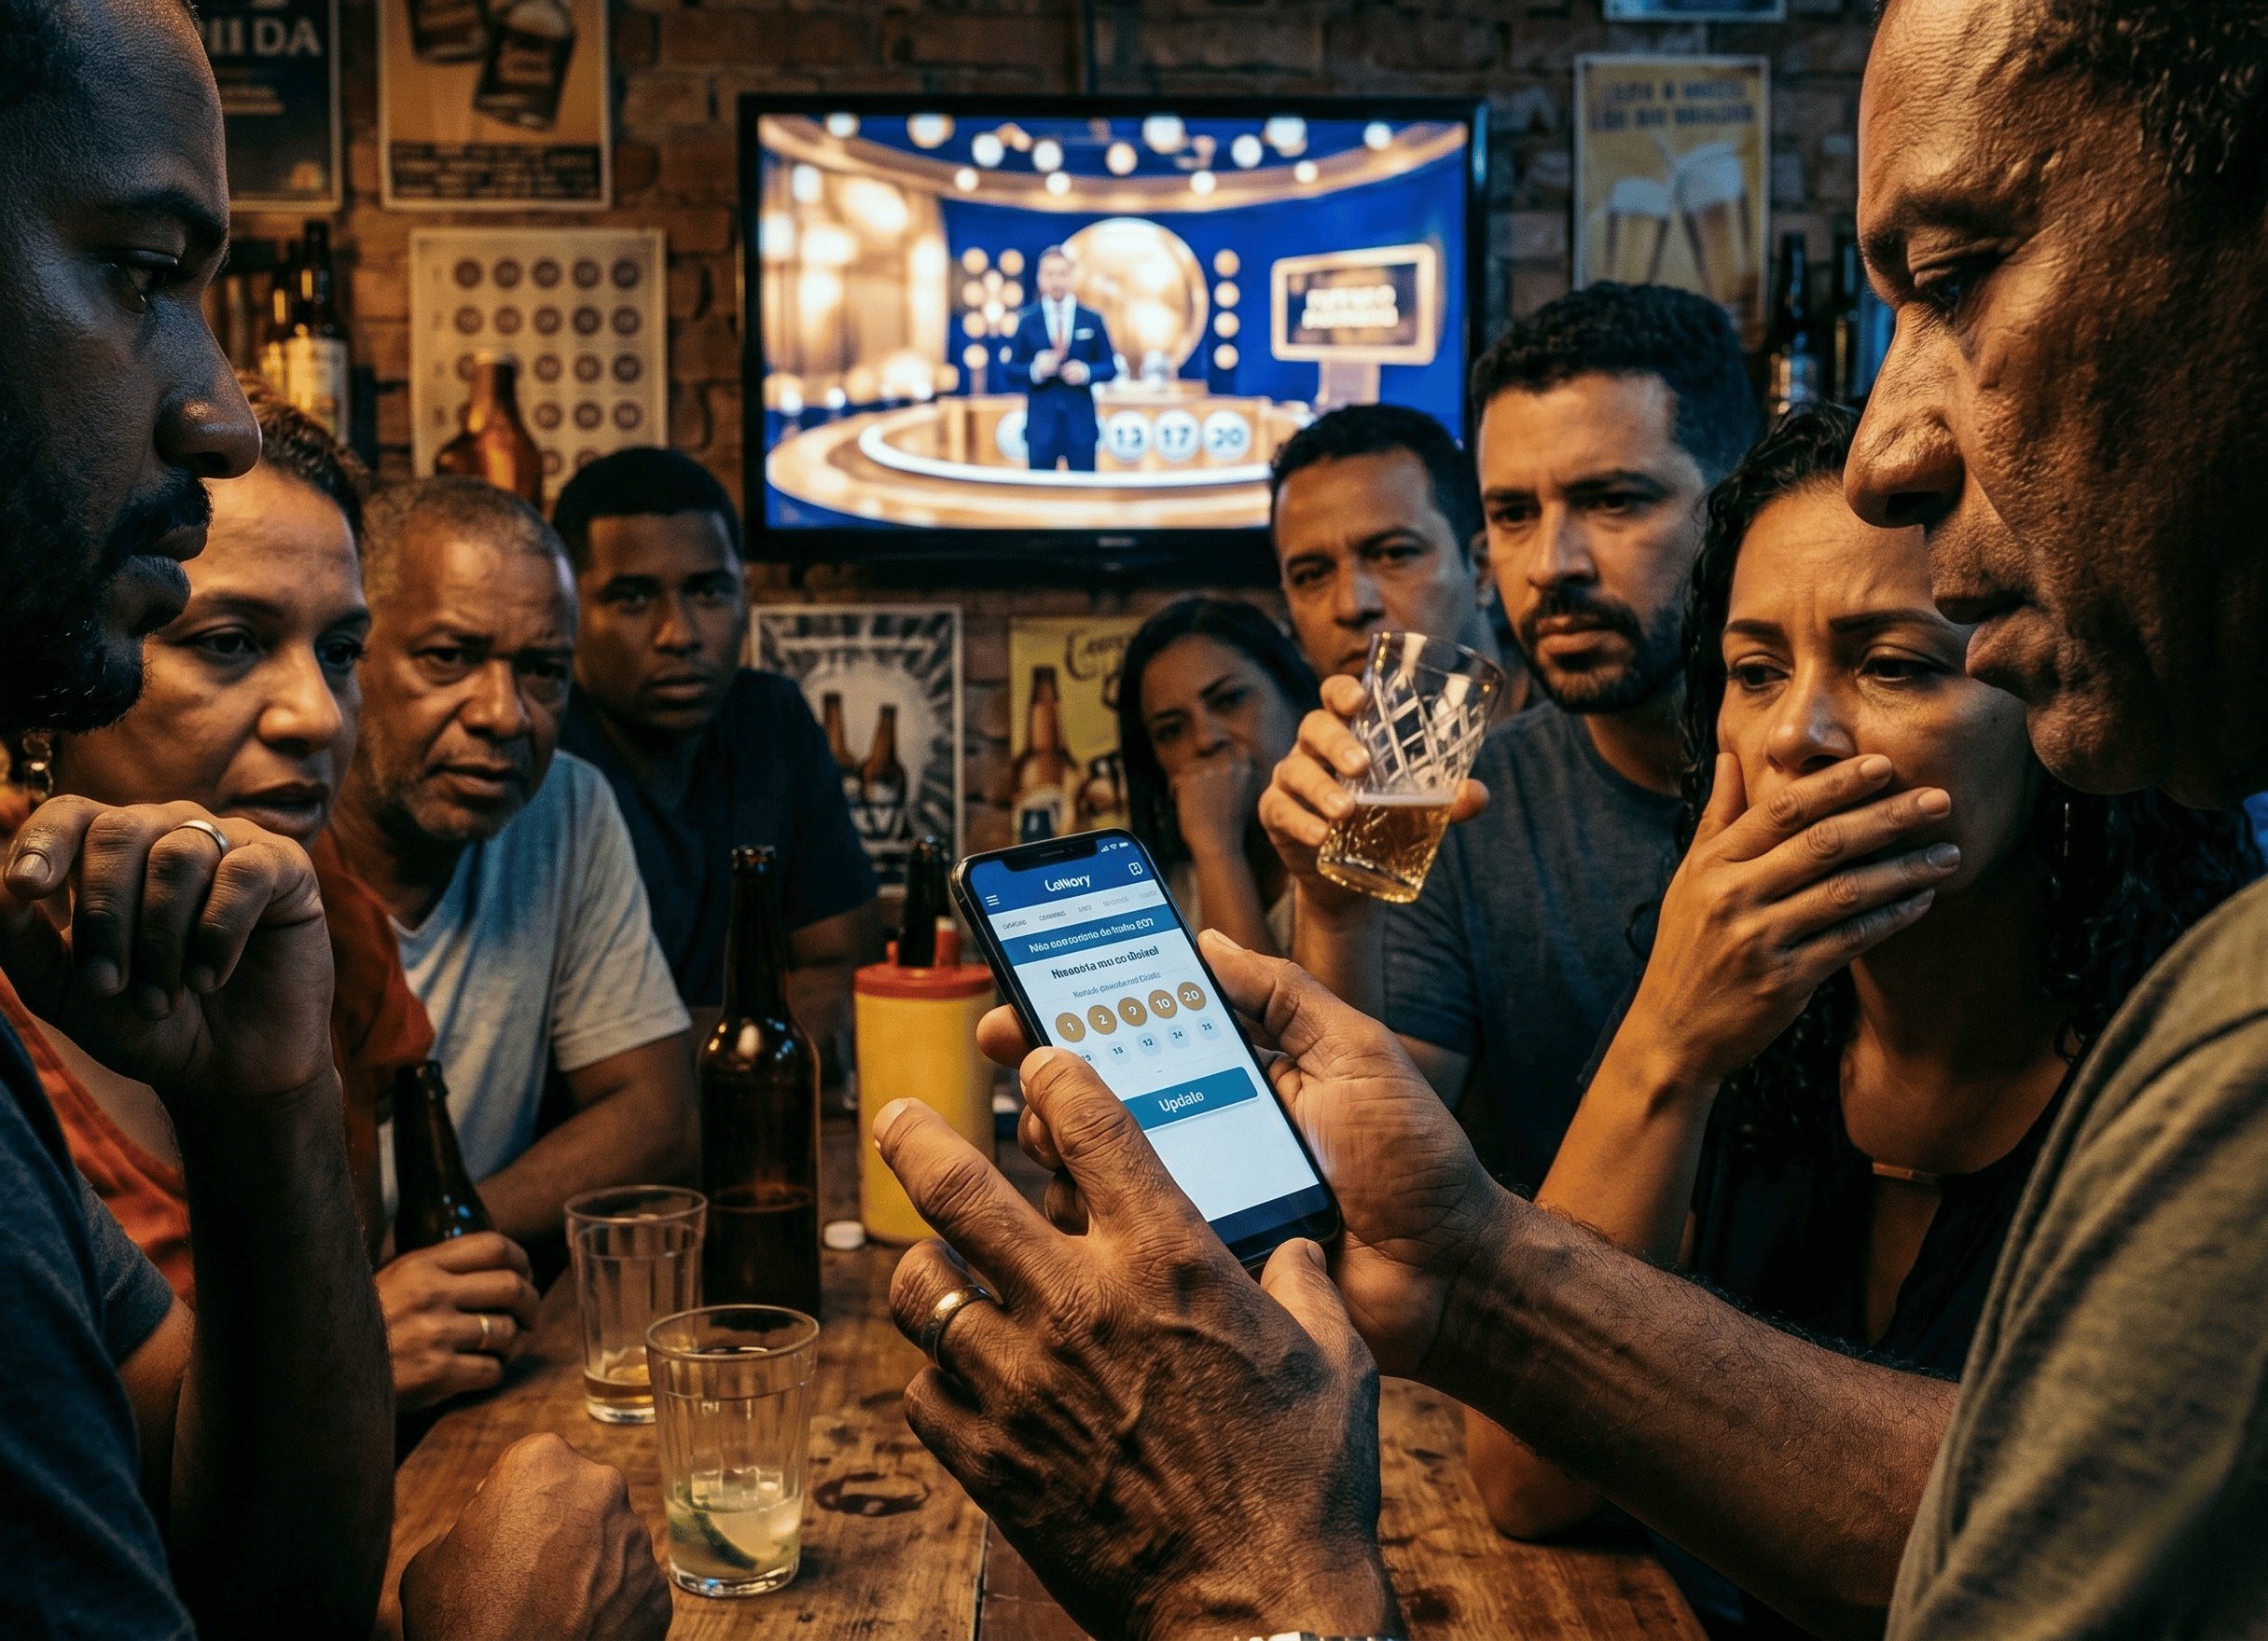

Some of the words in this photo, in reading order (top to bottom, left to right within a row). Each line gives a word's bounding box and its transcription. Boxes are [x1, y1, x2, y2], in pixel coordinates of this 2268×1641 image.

[1162, 424, 1190, 448] 17
[1067, 1022, 1075, 1032] 1
[1098, 1014, 1108, 1025] 2
[1127, 1006, 1138, 1016] 9
[1155, 998, 1171, 1010] 10
[1182, 990, 1200, 1002] 20
